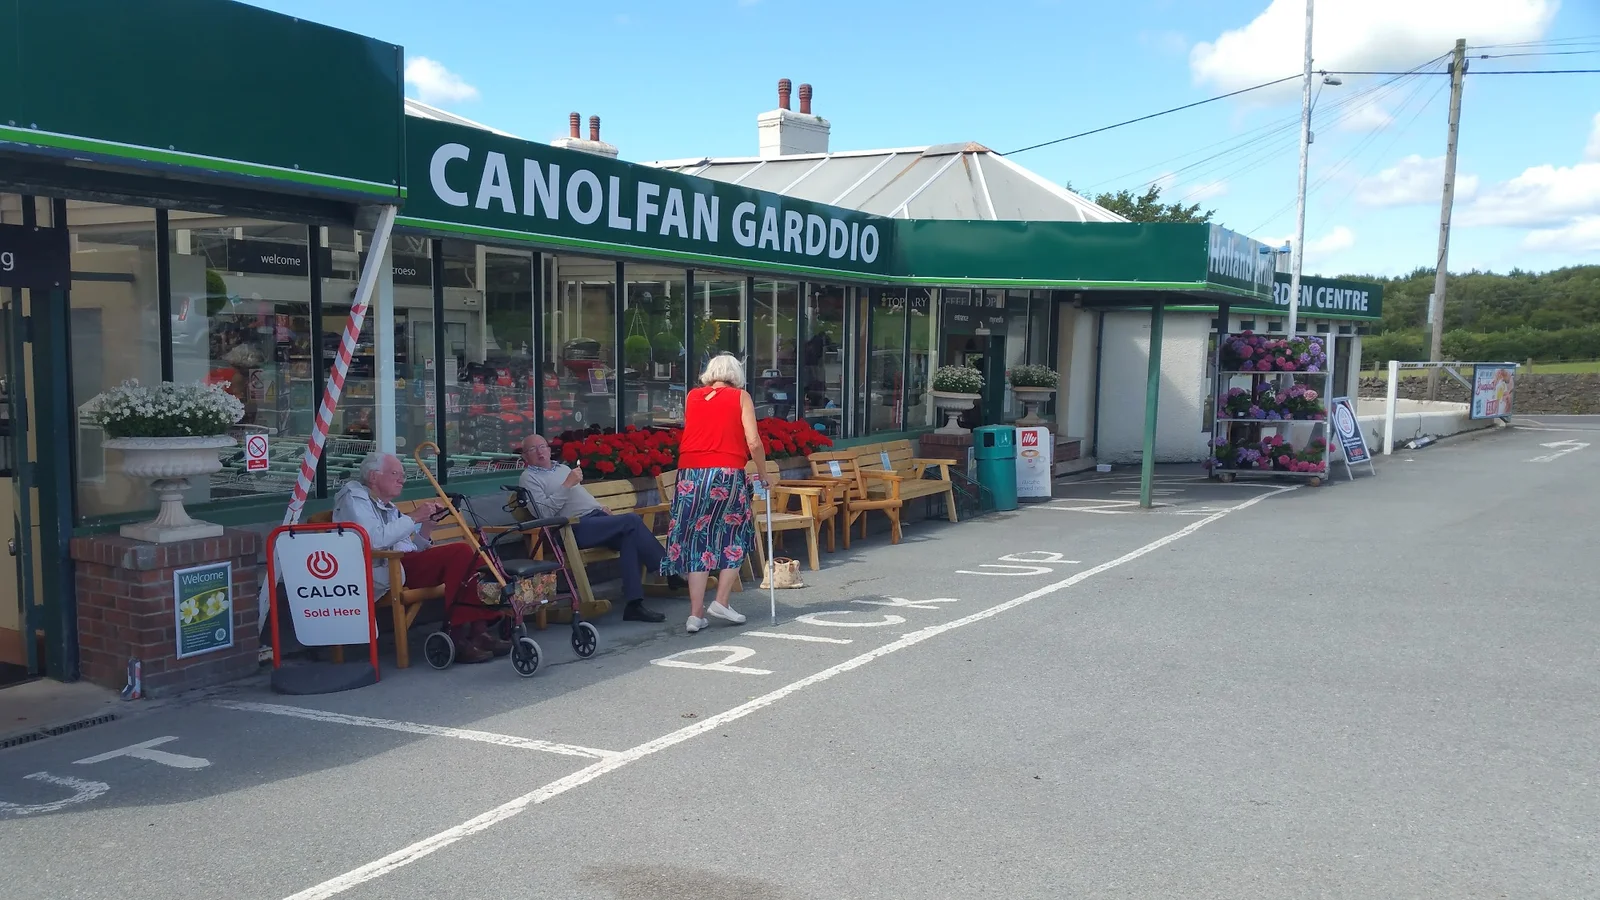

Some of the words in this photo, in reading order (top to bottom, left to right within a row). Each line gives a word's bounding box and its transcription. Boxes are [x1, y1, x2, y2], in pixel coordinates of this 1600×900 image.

[429, 142, 720, 243] CANOLFAN
[731, 201, 880, 264] GARDDIO
[260, 253, 301, 266] welcome
[1209, 230, 1254, 282] Holland
[1316, 286, 1369, 312] CENTRE
[1022, 433, 1037, 446] illy
[181, 571, 224, 586] Welcome
[296, 584, 361, 599] CALOR
[303, 608, 331, 618] Sold
[333, 608, 361, 617] Here
[649, 596, 961, 676] PICK
[954, 550, 1081, 577] UP
